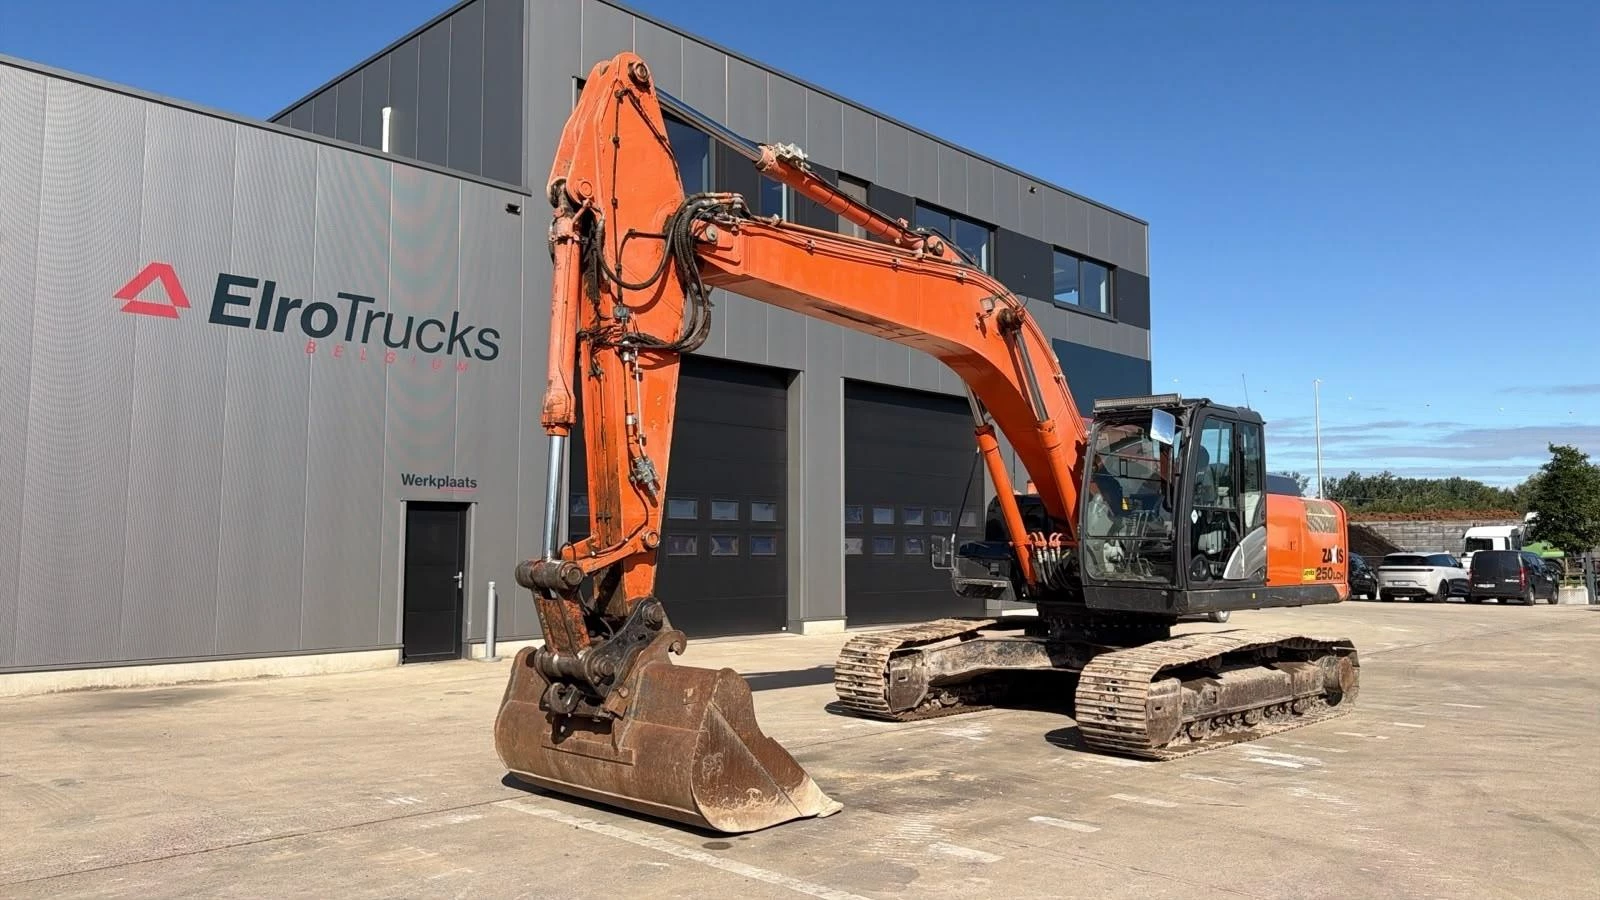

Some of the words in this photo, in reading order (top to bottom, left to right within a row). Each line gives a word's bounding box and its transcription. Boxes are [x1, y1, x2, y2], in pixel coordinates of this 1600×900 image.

[208, 273, 500, 361] ElroTrucks
[305, 340, 469, 373] BELGIUM
[401, 473, 478, 489] Werkplaats
